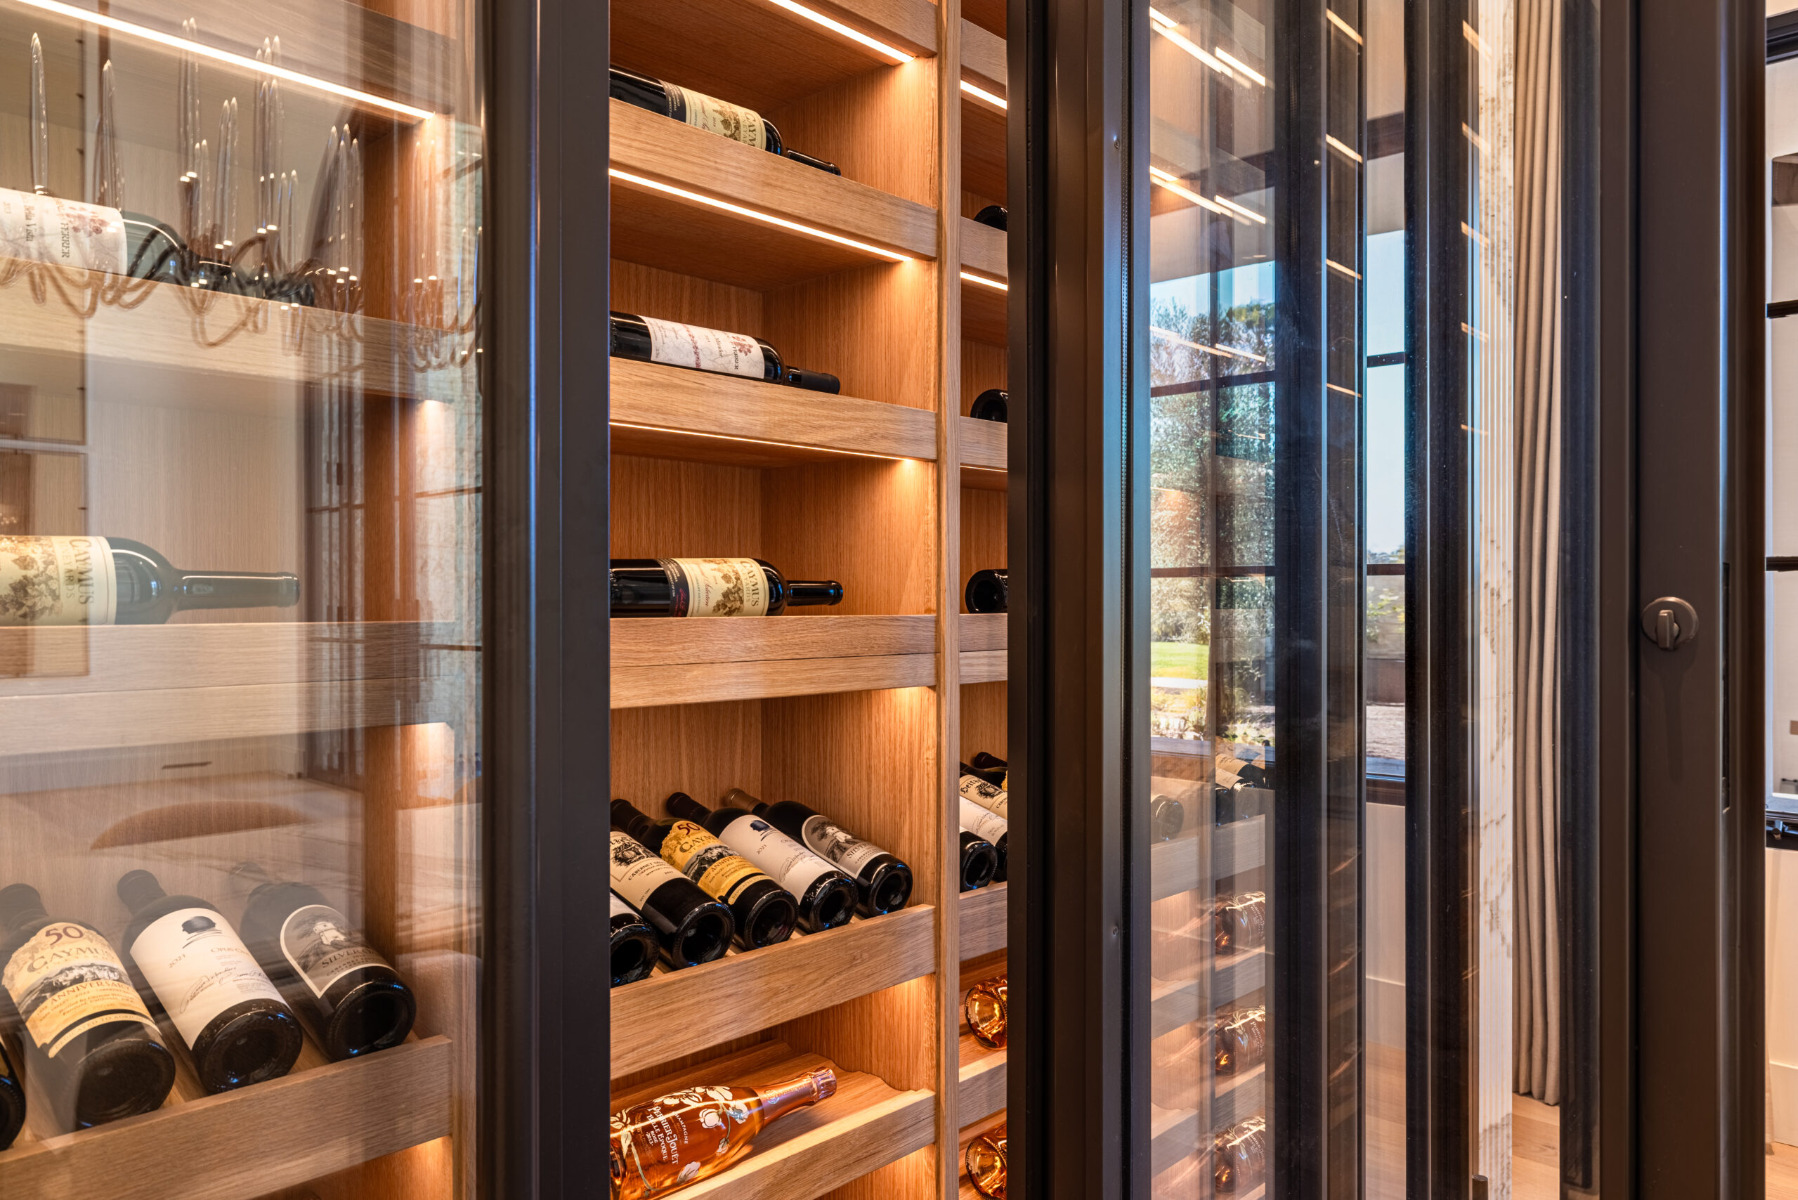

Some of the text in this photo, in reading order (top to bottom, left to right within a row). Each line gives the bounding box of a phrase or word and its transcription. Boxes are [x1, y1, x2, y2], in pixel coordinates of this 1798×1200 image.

[69, 539, 94, 605] CAYMUS
[740, 561, 760, 607] CAYMUS
[677, 822, 700, 836] 50
[45, 926, 84, 946] 50
[674, 1113, 688, 1144] HAMPAGNE
